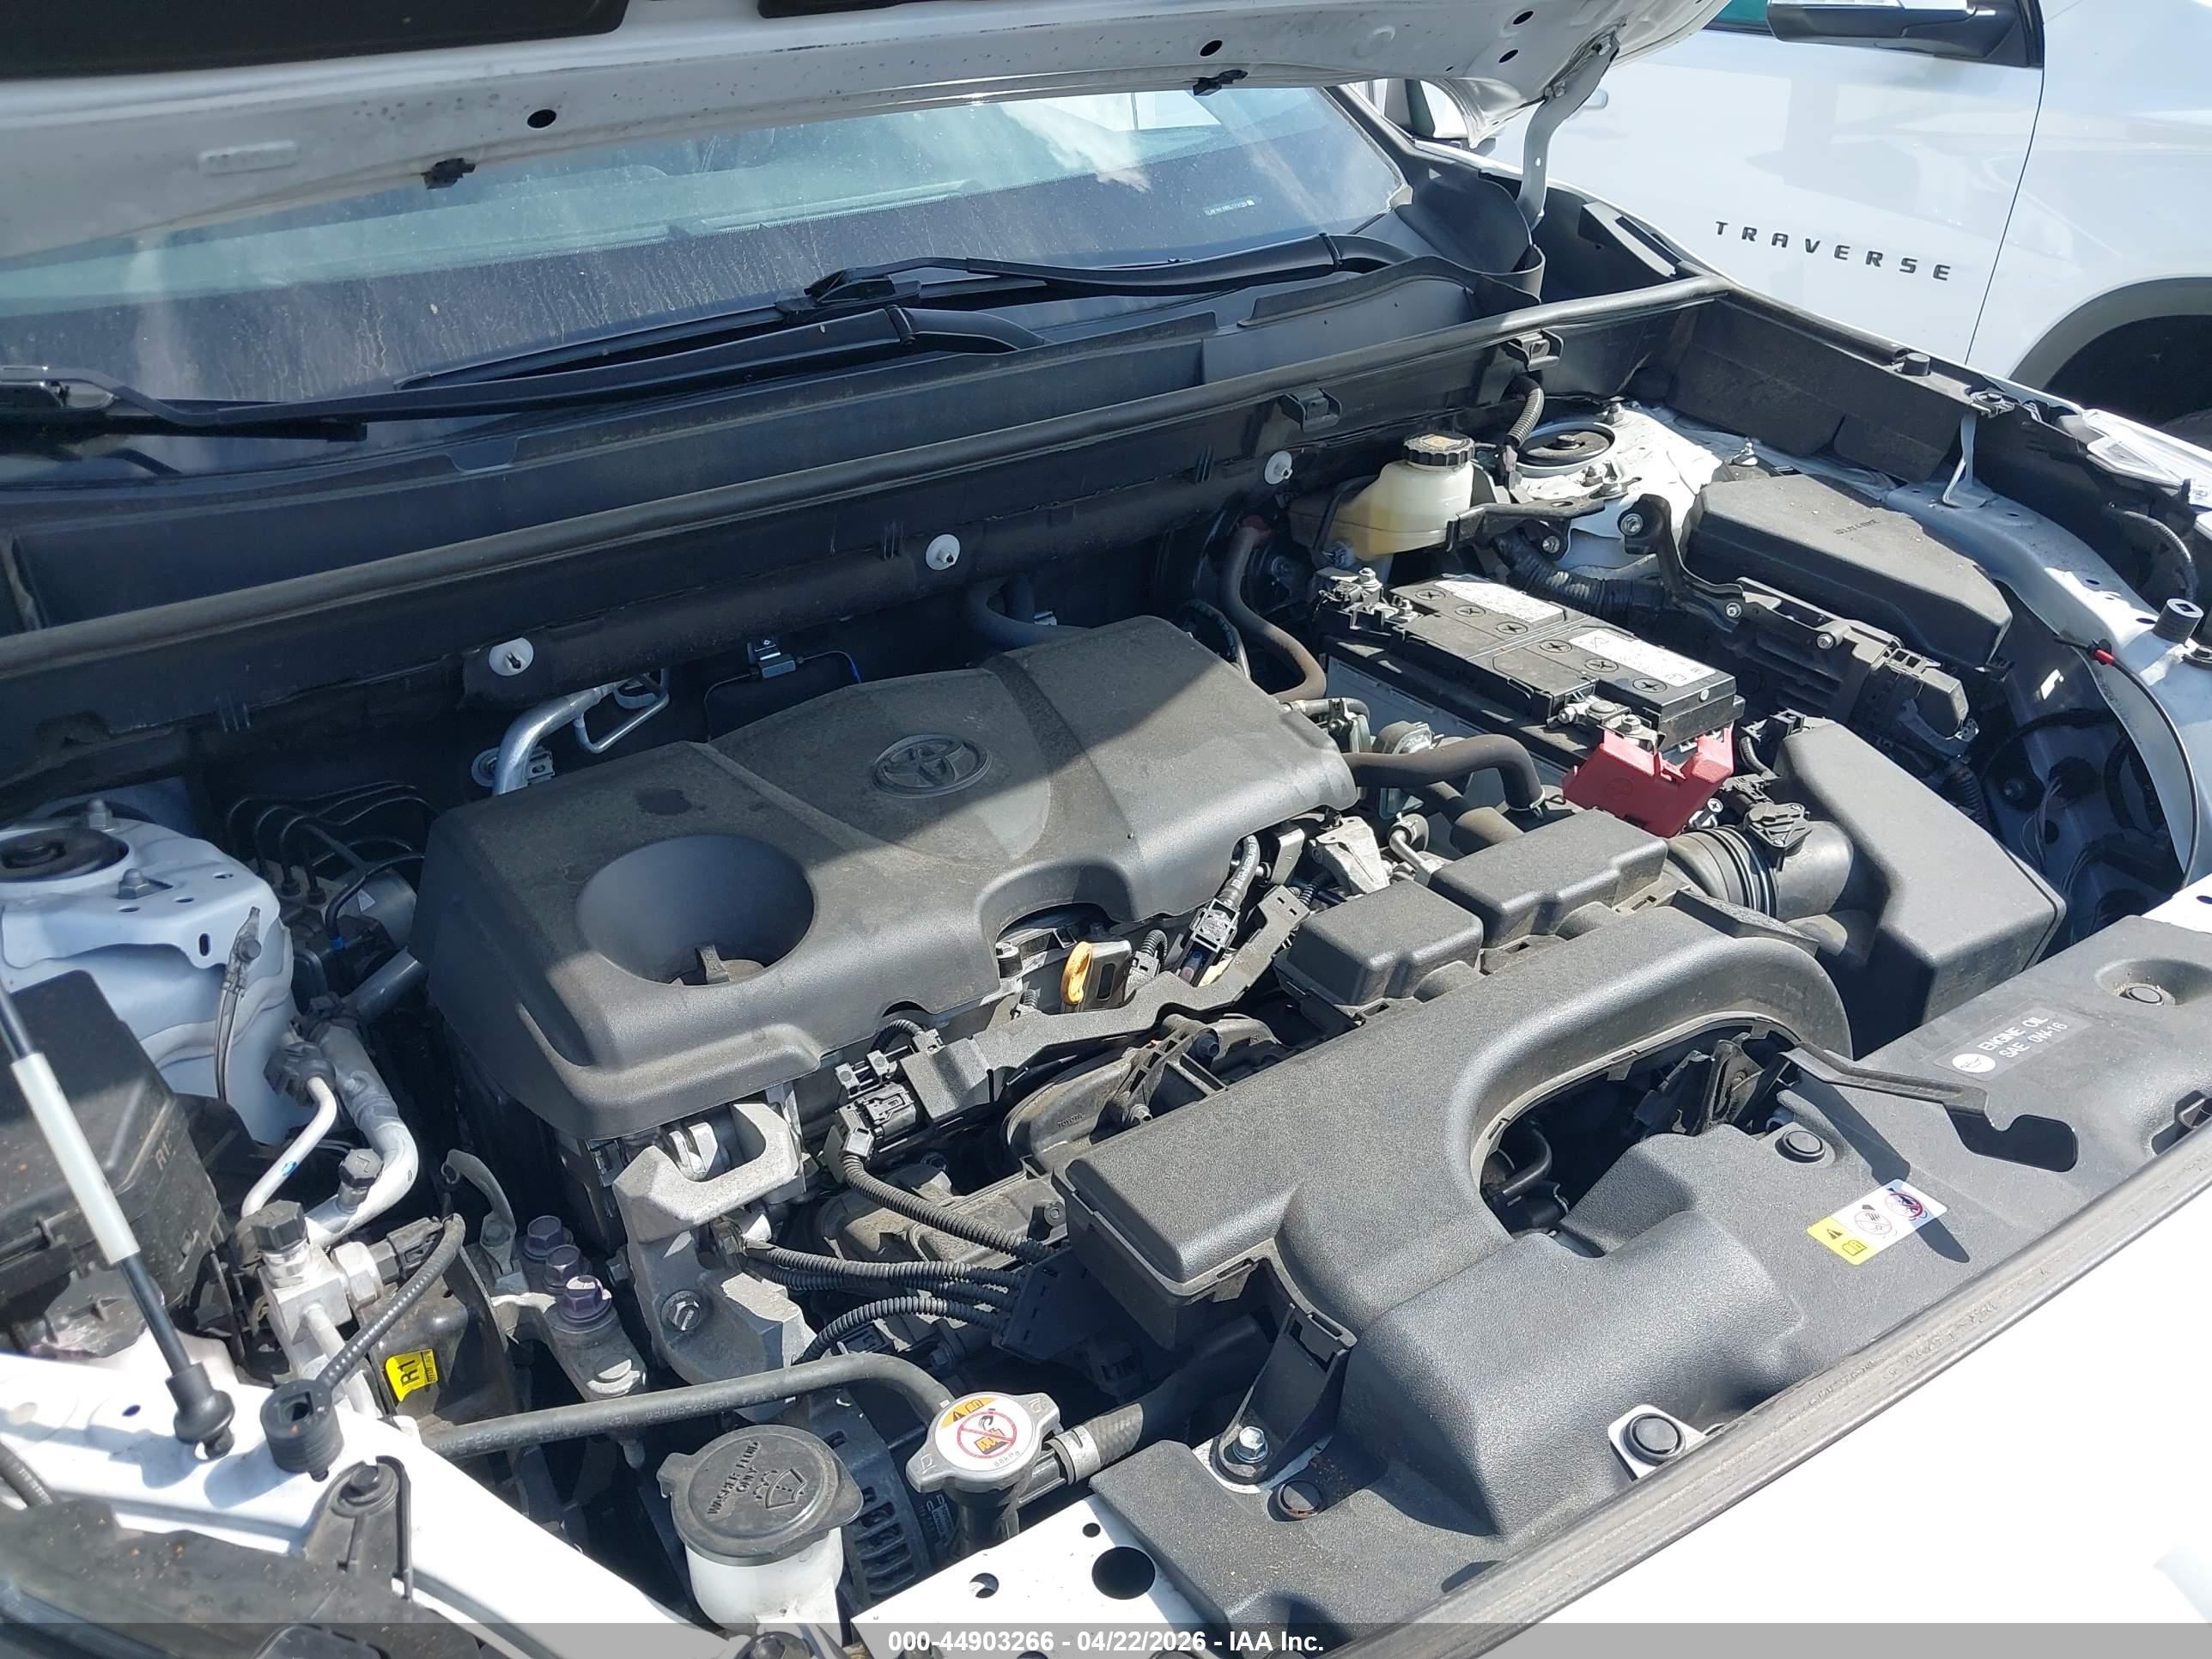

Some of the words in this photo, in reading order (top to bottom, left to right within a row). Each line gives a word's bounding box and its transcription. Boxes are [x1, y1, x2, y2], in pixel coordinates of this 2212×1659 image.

[1716, 221, 1951, 281] TRAVERSE
[1976, 1026, 2027, 1051] ENGINE
[2021, 1017, 2049, 1028] OIL
[1999, 1042, 2031, 1058] SAE
[2027, 1022, 2069, 1043] 0W-16
[398, 1359, 420, 1388] R1
